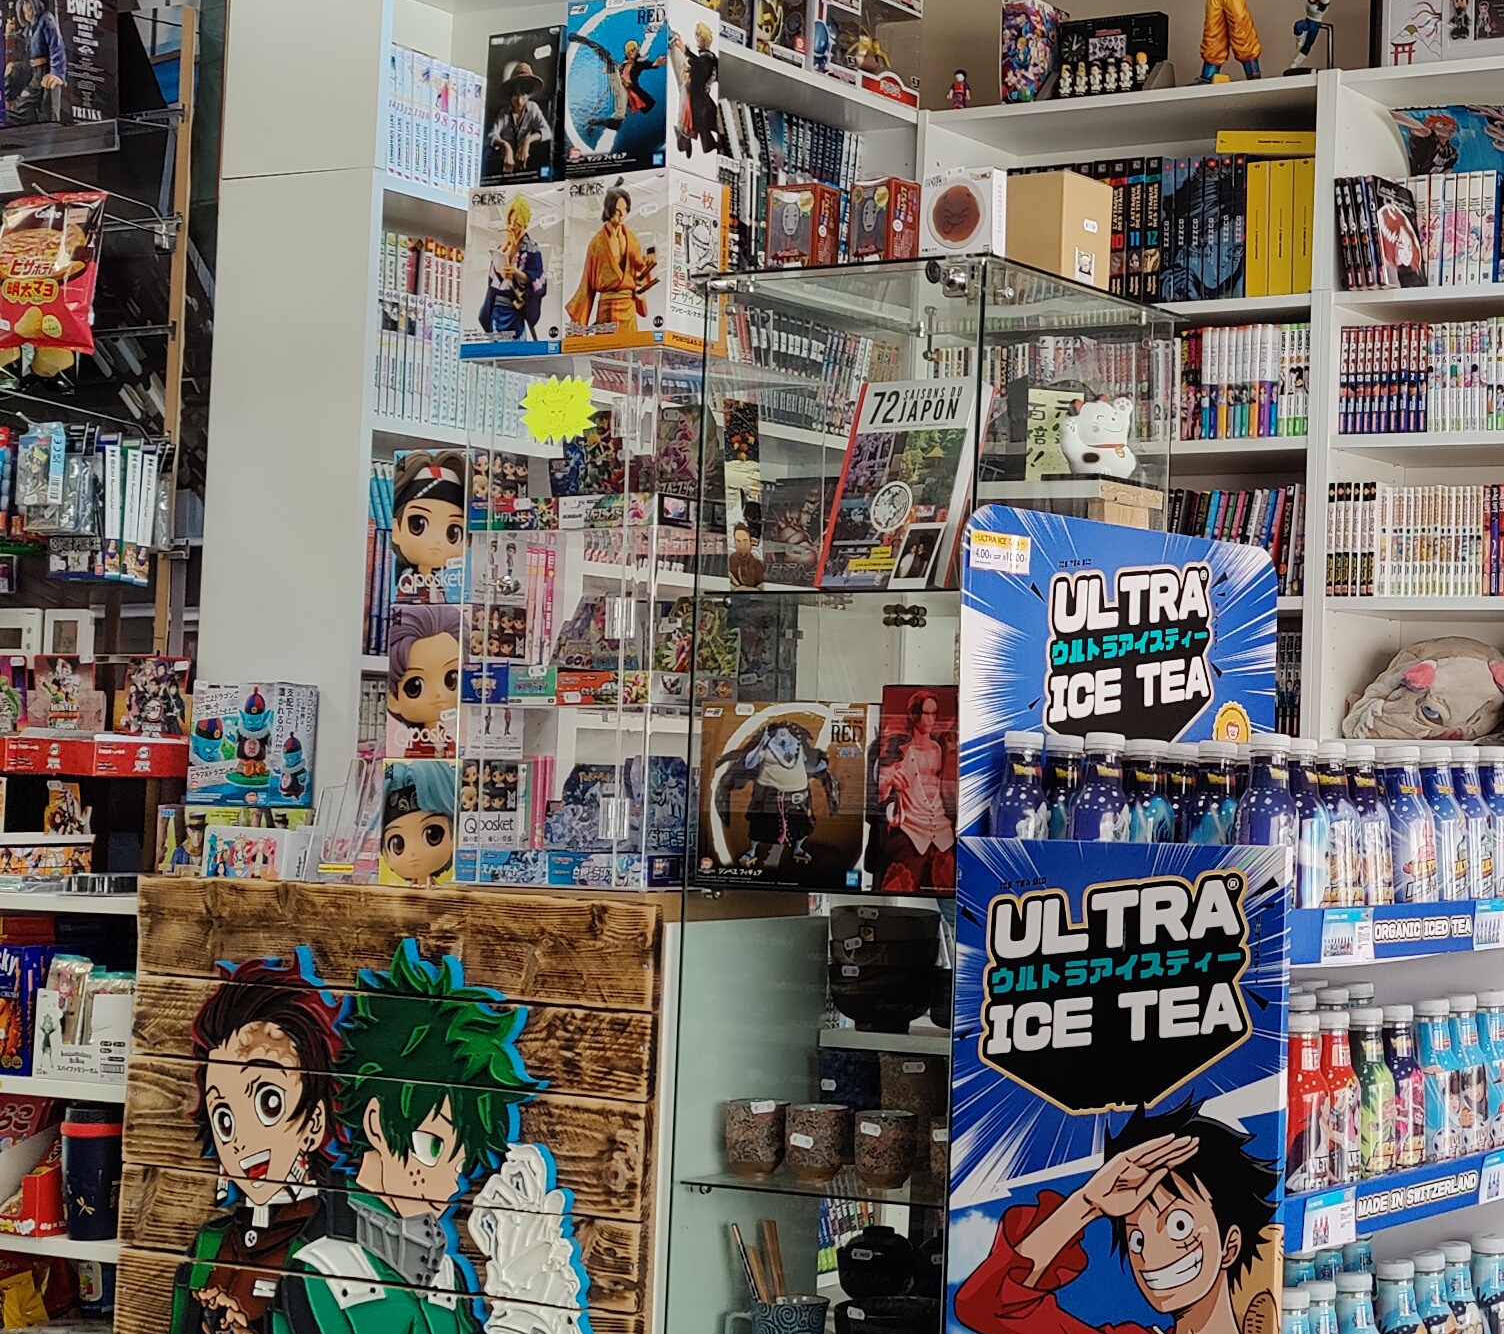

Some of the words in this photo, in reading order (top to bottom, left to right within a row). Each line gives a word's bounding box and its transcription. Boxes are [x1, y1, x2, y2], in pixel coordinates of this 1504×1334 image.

[1130, 231, 1140, 247] 11
[1147, 230, 1158, 246] 12
[869, 390, 900, 425] 72
[903, 387, 947, 400] SAISONS
[950, 385, 963, 397] DU
[898, 397, 960, 424] JAPON
[1052, 570, 1209, 633] ULTRA
[1052, 628, 1208, 666] ウルトラアイスティー
[1050, 668, 1122, 723] ICE
[1136, 656, 1209, 708] TEA
[830, 724, 863, 743] RED
[994, 879, 1241, 959] ULTRA
[1374, 919, 1421, 942] ORGANIC
[1423, 918, 1449, 937] ICED
[1452, 916, 1473, 935] TEA
[991, 949, 1242, 994] ウルトラアイスティー
[986, 996, 1094, 1055] ICE
[1118, 982, 1243, 1042] TEA
[1357, 1195, 1388, 1219] MADE
[1391, 1191, 1404, 1210] IN
[1406, 1170, 1478, 1208] SWITZERLAND
